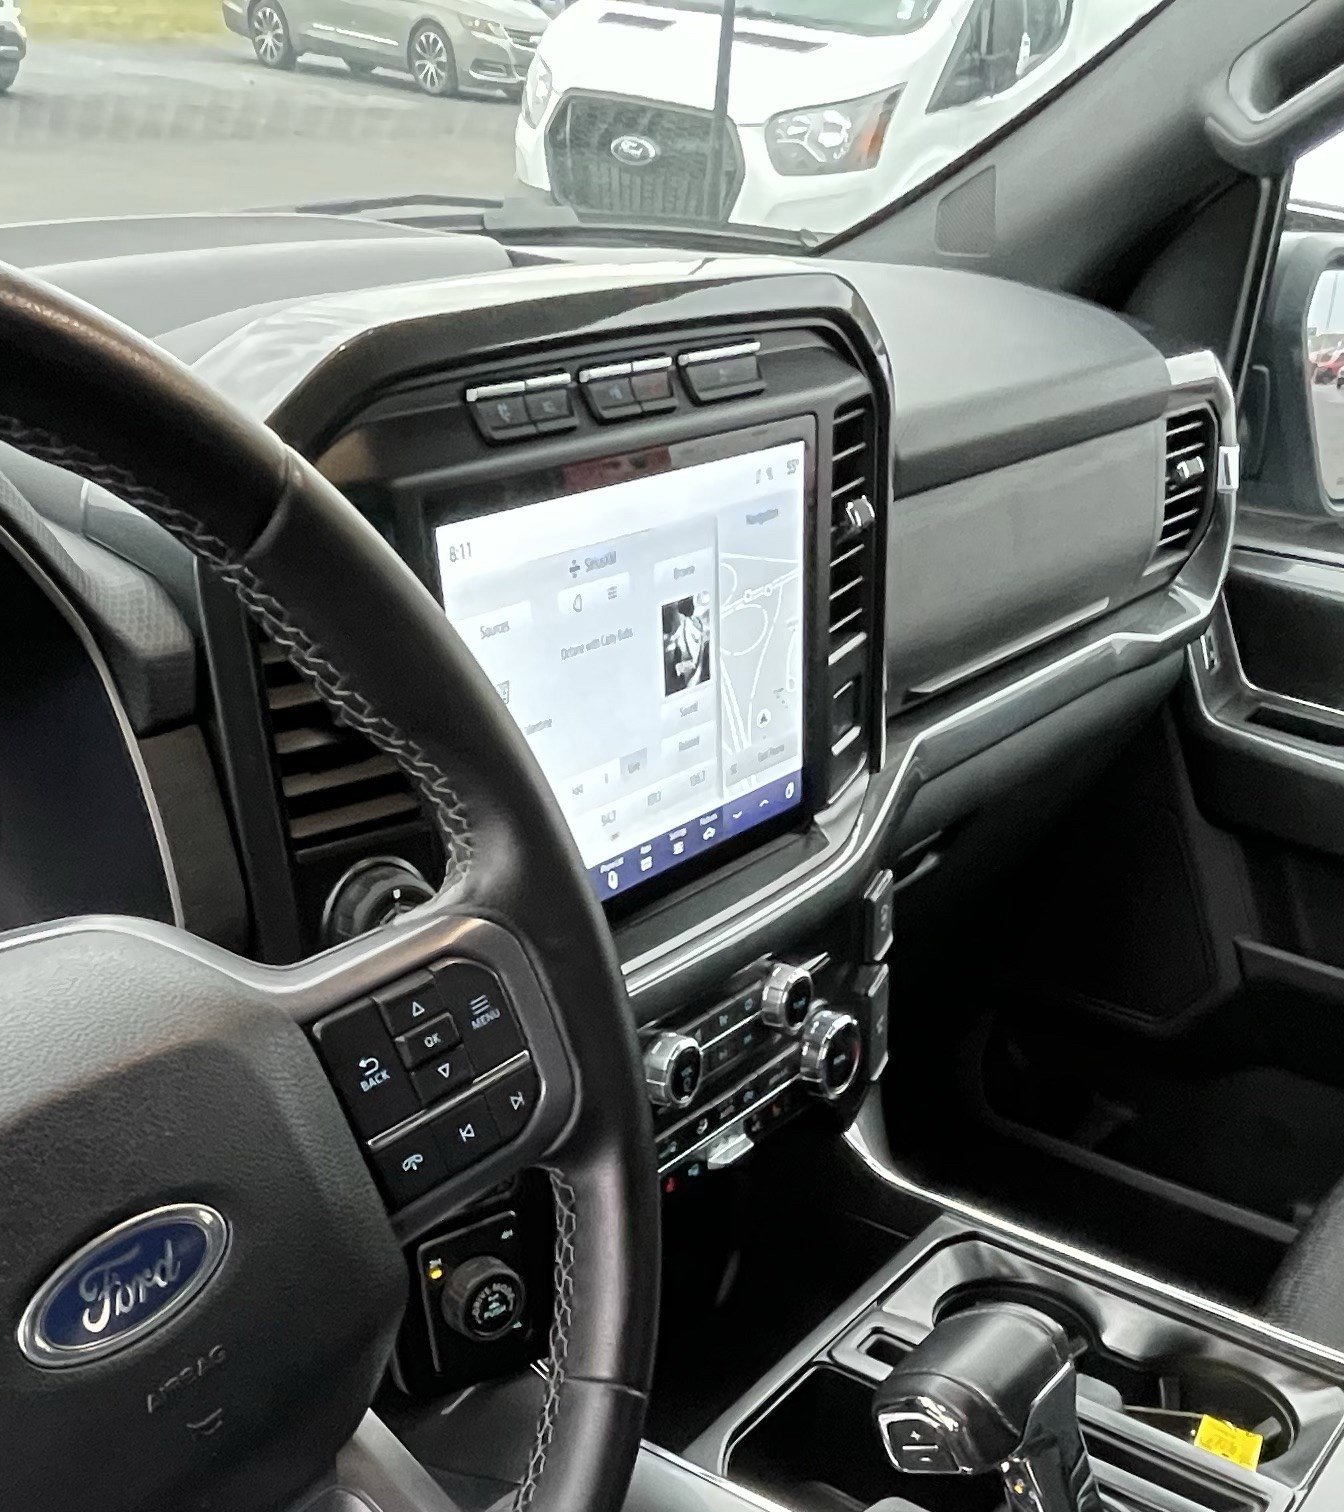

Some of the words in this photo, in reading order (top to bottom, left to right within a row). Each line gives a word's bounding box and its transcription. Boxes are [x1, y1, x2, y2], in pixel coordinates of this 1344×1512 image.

[449, 542, 472, 562] 8:11
[470, 1008, 501, 1030] MENU
[424, 1033, 442, 1048] OK
[359, 1069, 391, 1092] BACK
[79, 1239, 181, 1333] Ford
